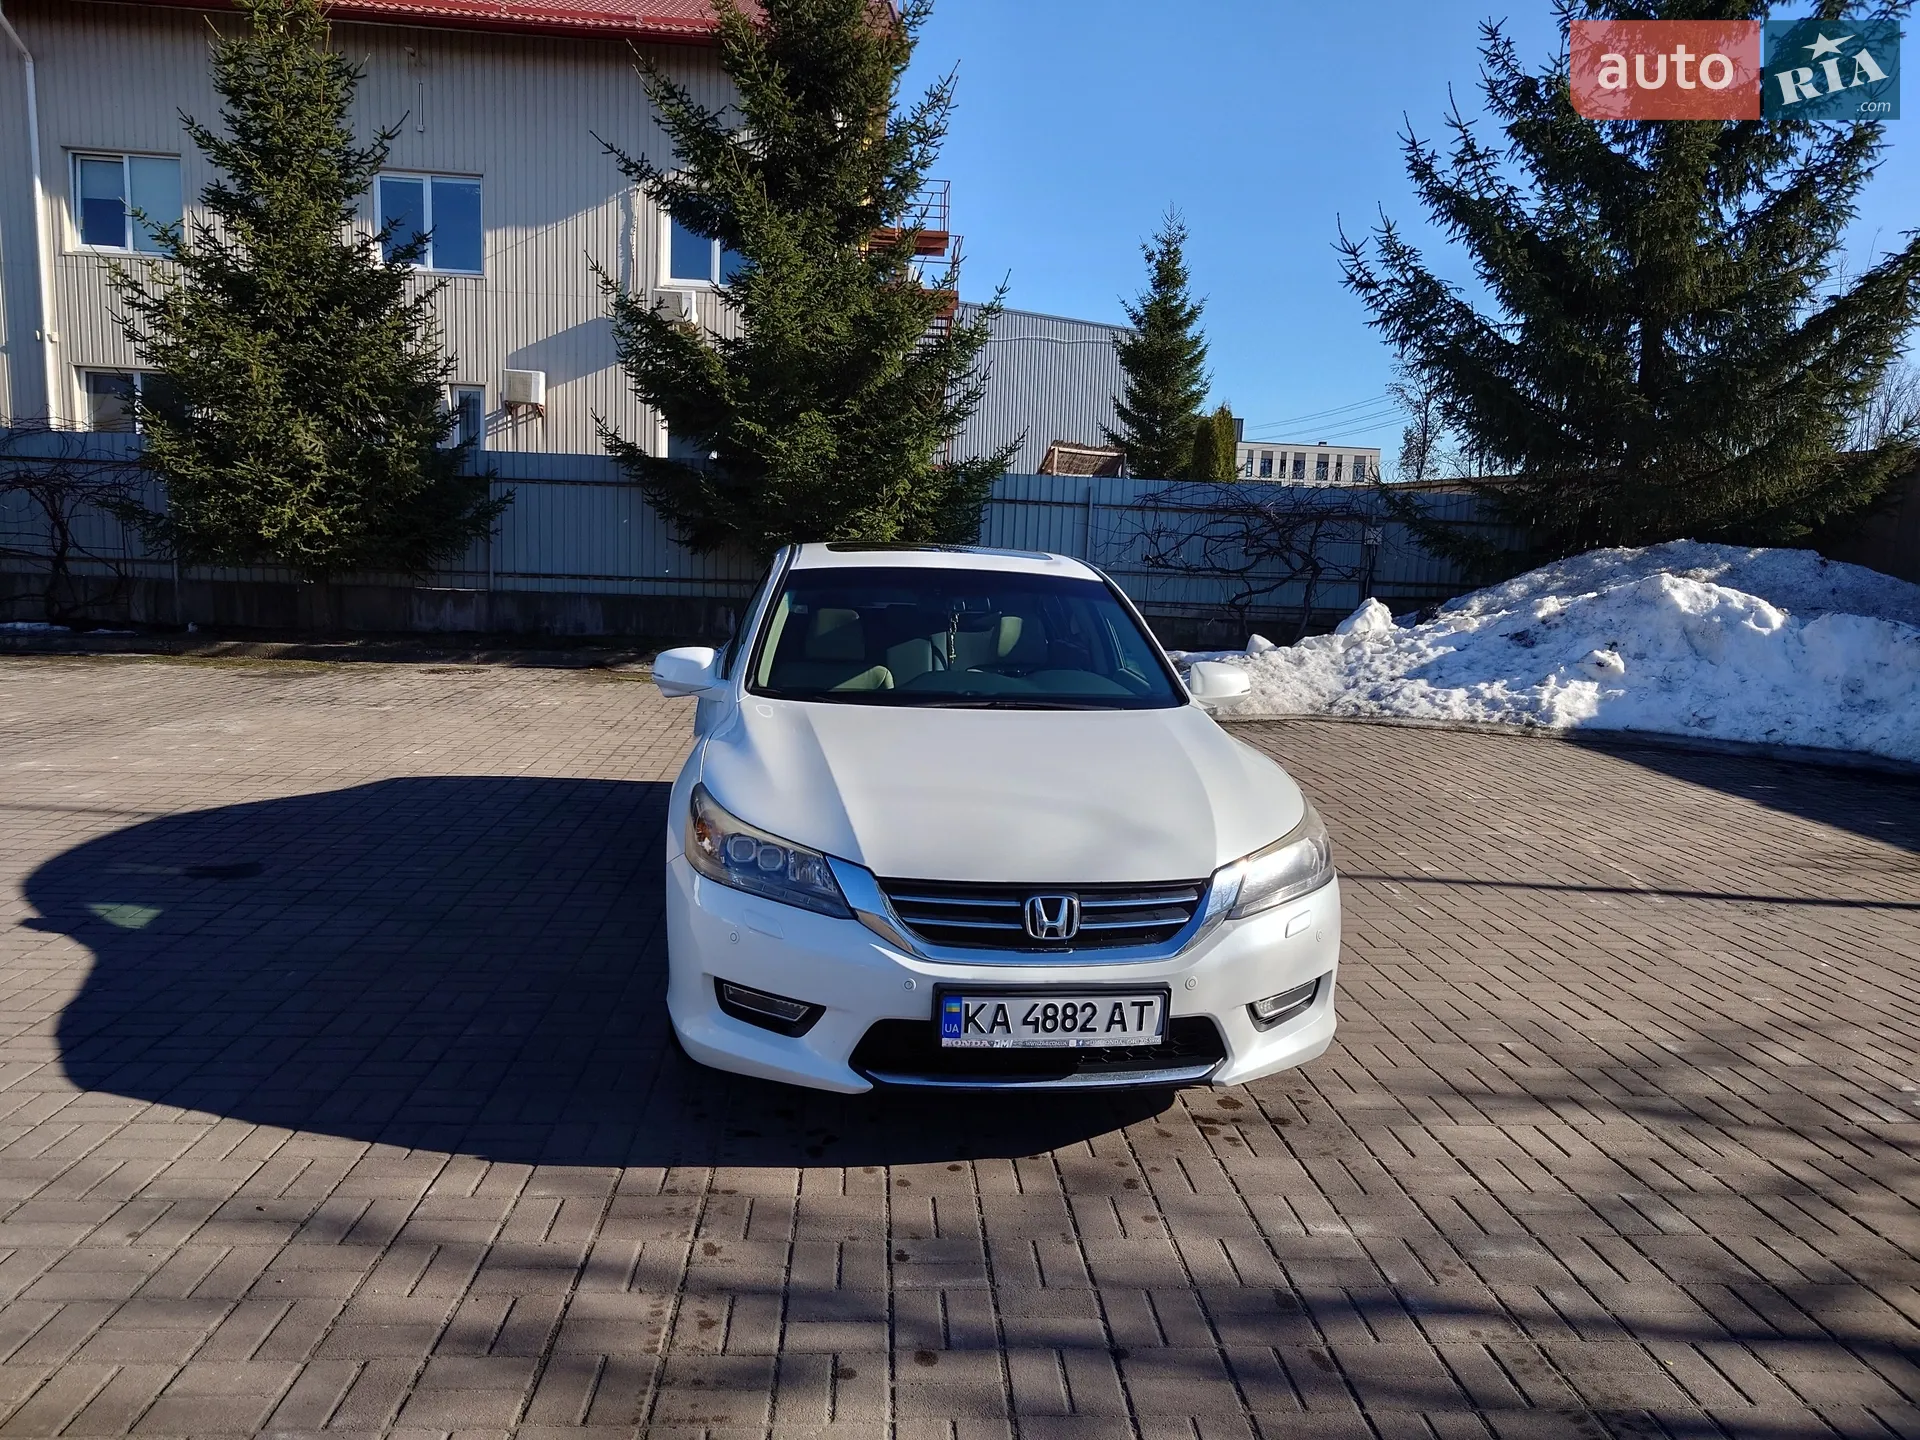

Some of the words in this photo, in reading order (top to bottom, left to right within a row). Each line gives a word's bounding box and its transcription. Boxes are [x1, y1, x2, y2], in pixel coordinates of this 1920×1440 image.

[944, 1023, 959, 1033] UA
[964, 1002, 1012, 1034] KA
[1022, 1002, 1098, 1034] 4882
[1105, 1000, 1154, 1033] AT
